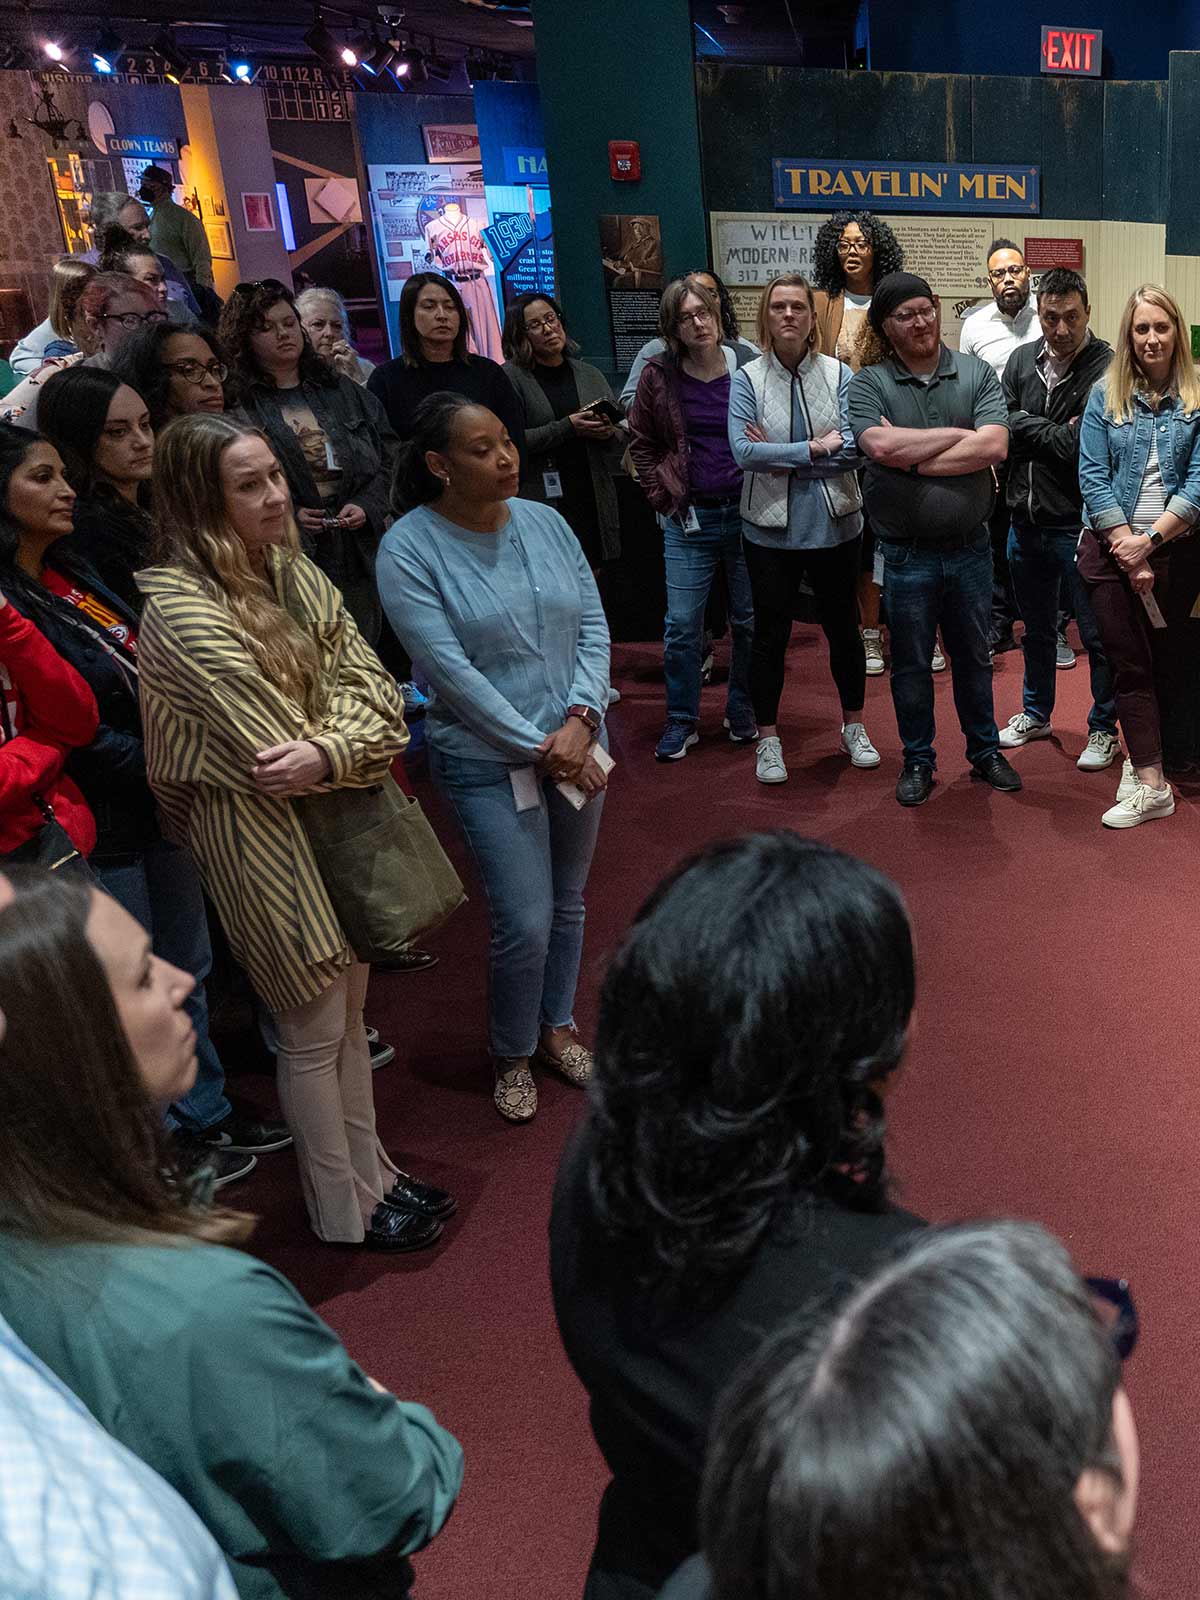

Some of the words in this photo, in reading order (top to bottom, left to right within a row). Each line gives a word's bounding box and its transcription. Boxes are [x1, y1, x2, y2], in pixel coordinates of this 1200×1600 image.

[1048, 31, 1096, 71] EXIT
[127, 58, 138, 73] 2
[145, 58, 155, 74] 3
[110, 138, 142, 152] CLOWN
[143, 140, 175, 154] TEAMS
[785, 169, 948, 197] TRAVELIN'
[959, 174, 1026, 199] MEN
[488, 213, 533, 259] 1930
[726, 247, 789, 265] MODERN
